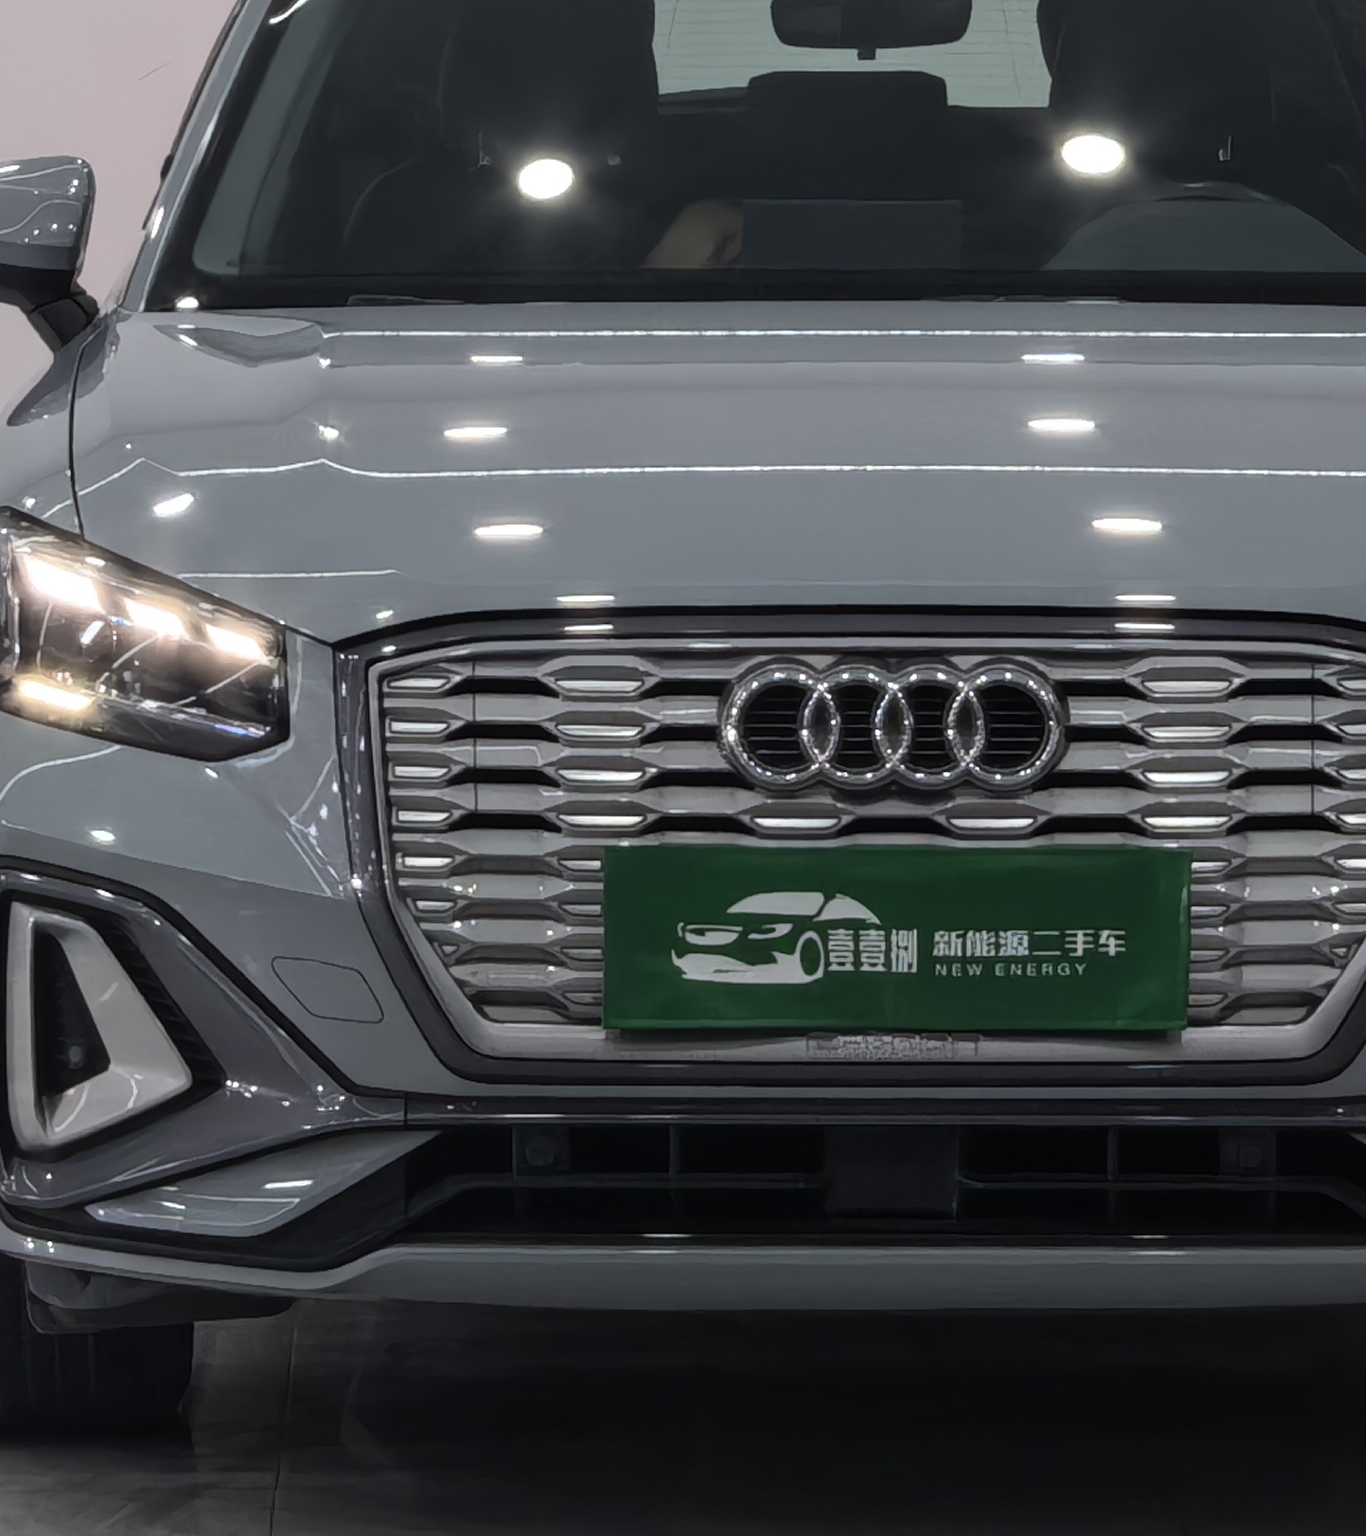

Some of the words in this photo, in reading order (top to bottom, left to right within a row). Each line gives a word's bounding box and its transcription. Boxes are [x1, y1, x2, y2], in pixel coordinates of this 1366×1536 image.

[932, 929, 1127, 958] 新能源二手车
[935, 963, 983, 977] NEW
[994, 963, 1087, 977] ENERGY
